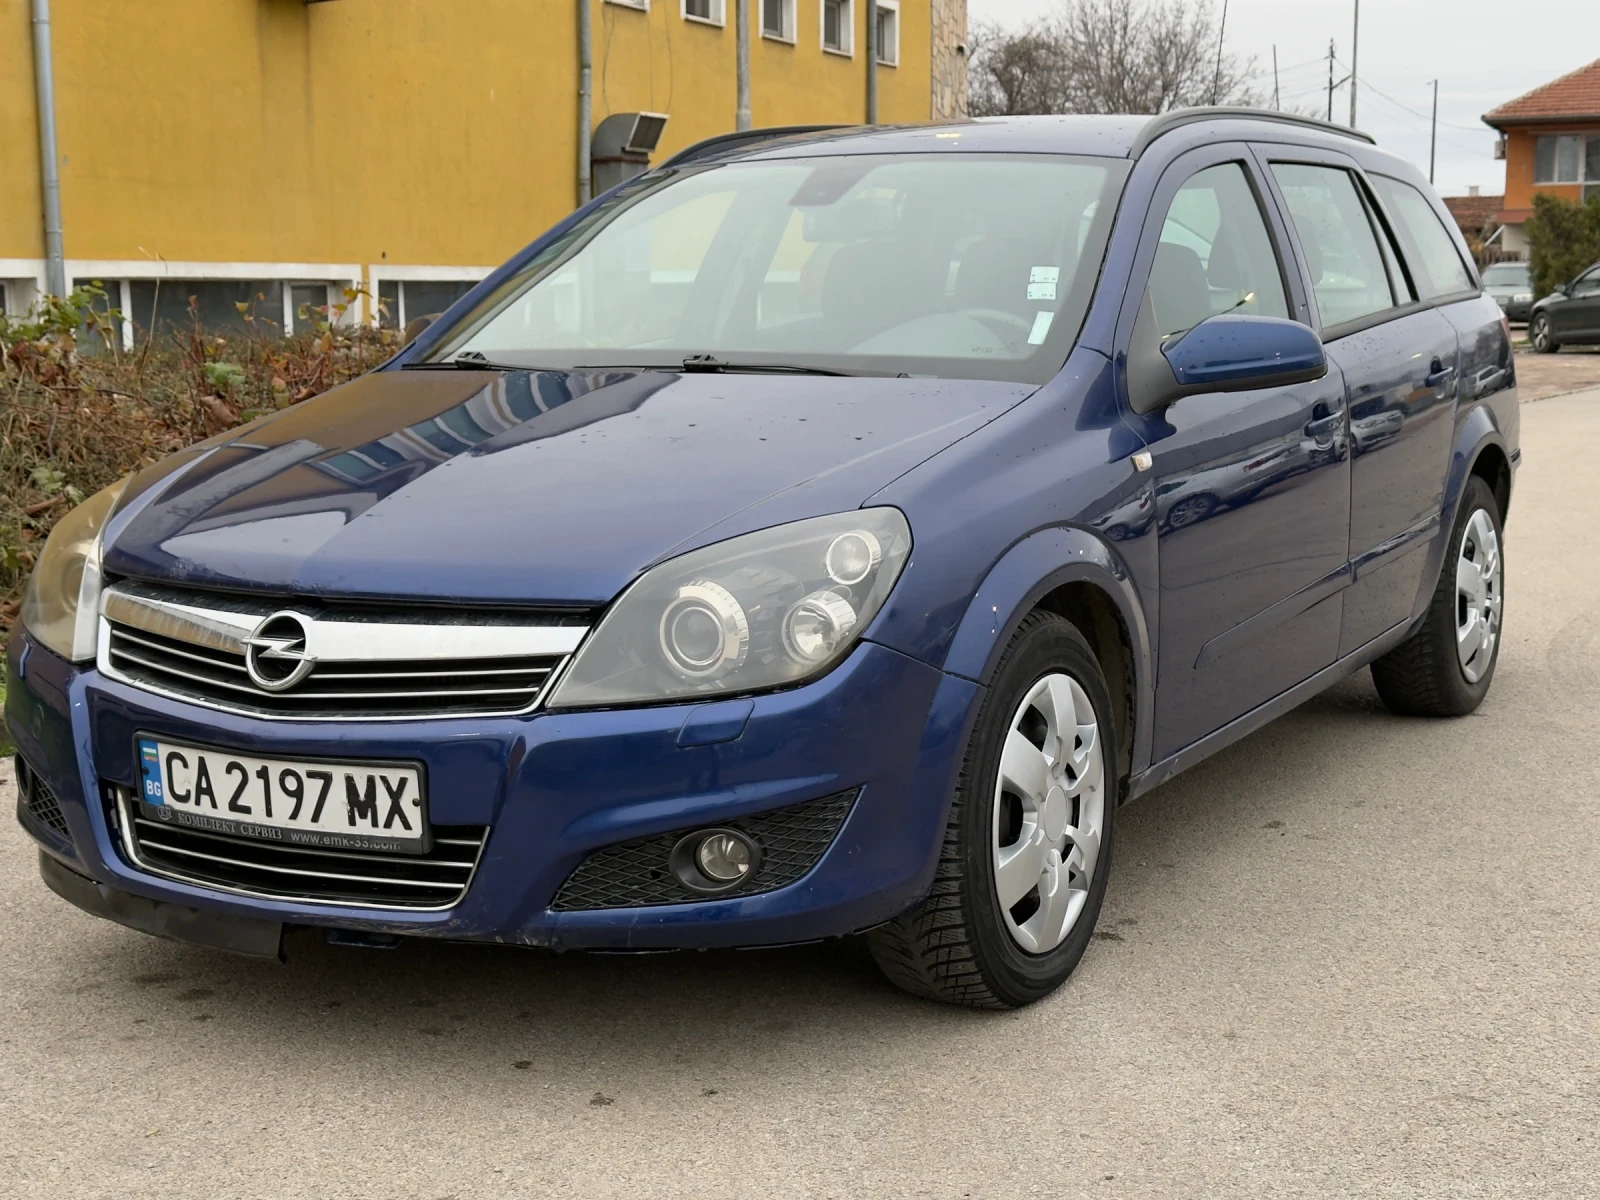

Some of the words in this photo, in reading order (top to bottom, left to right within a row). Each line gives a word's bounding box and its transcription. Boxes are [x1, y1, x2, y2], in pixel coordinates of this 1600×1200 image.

[146, 779, 162, 797] BG
[165, 751, 218, 810] CA
[225, 761, 333, 823] 2197
[344, 772, 413, 831] MX
[177, 812, 237, 832] КОМПЛЕКТ
[240, 824, 283, 840] СЕРВИЗ
